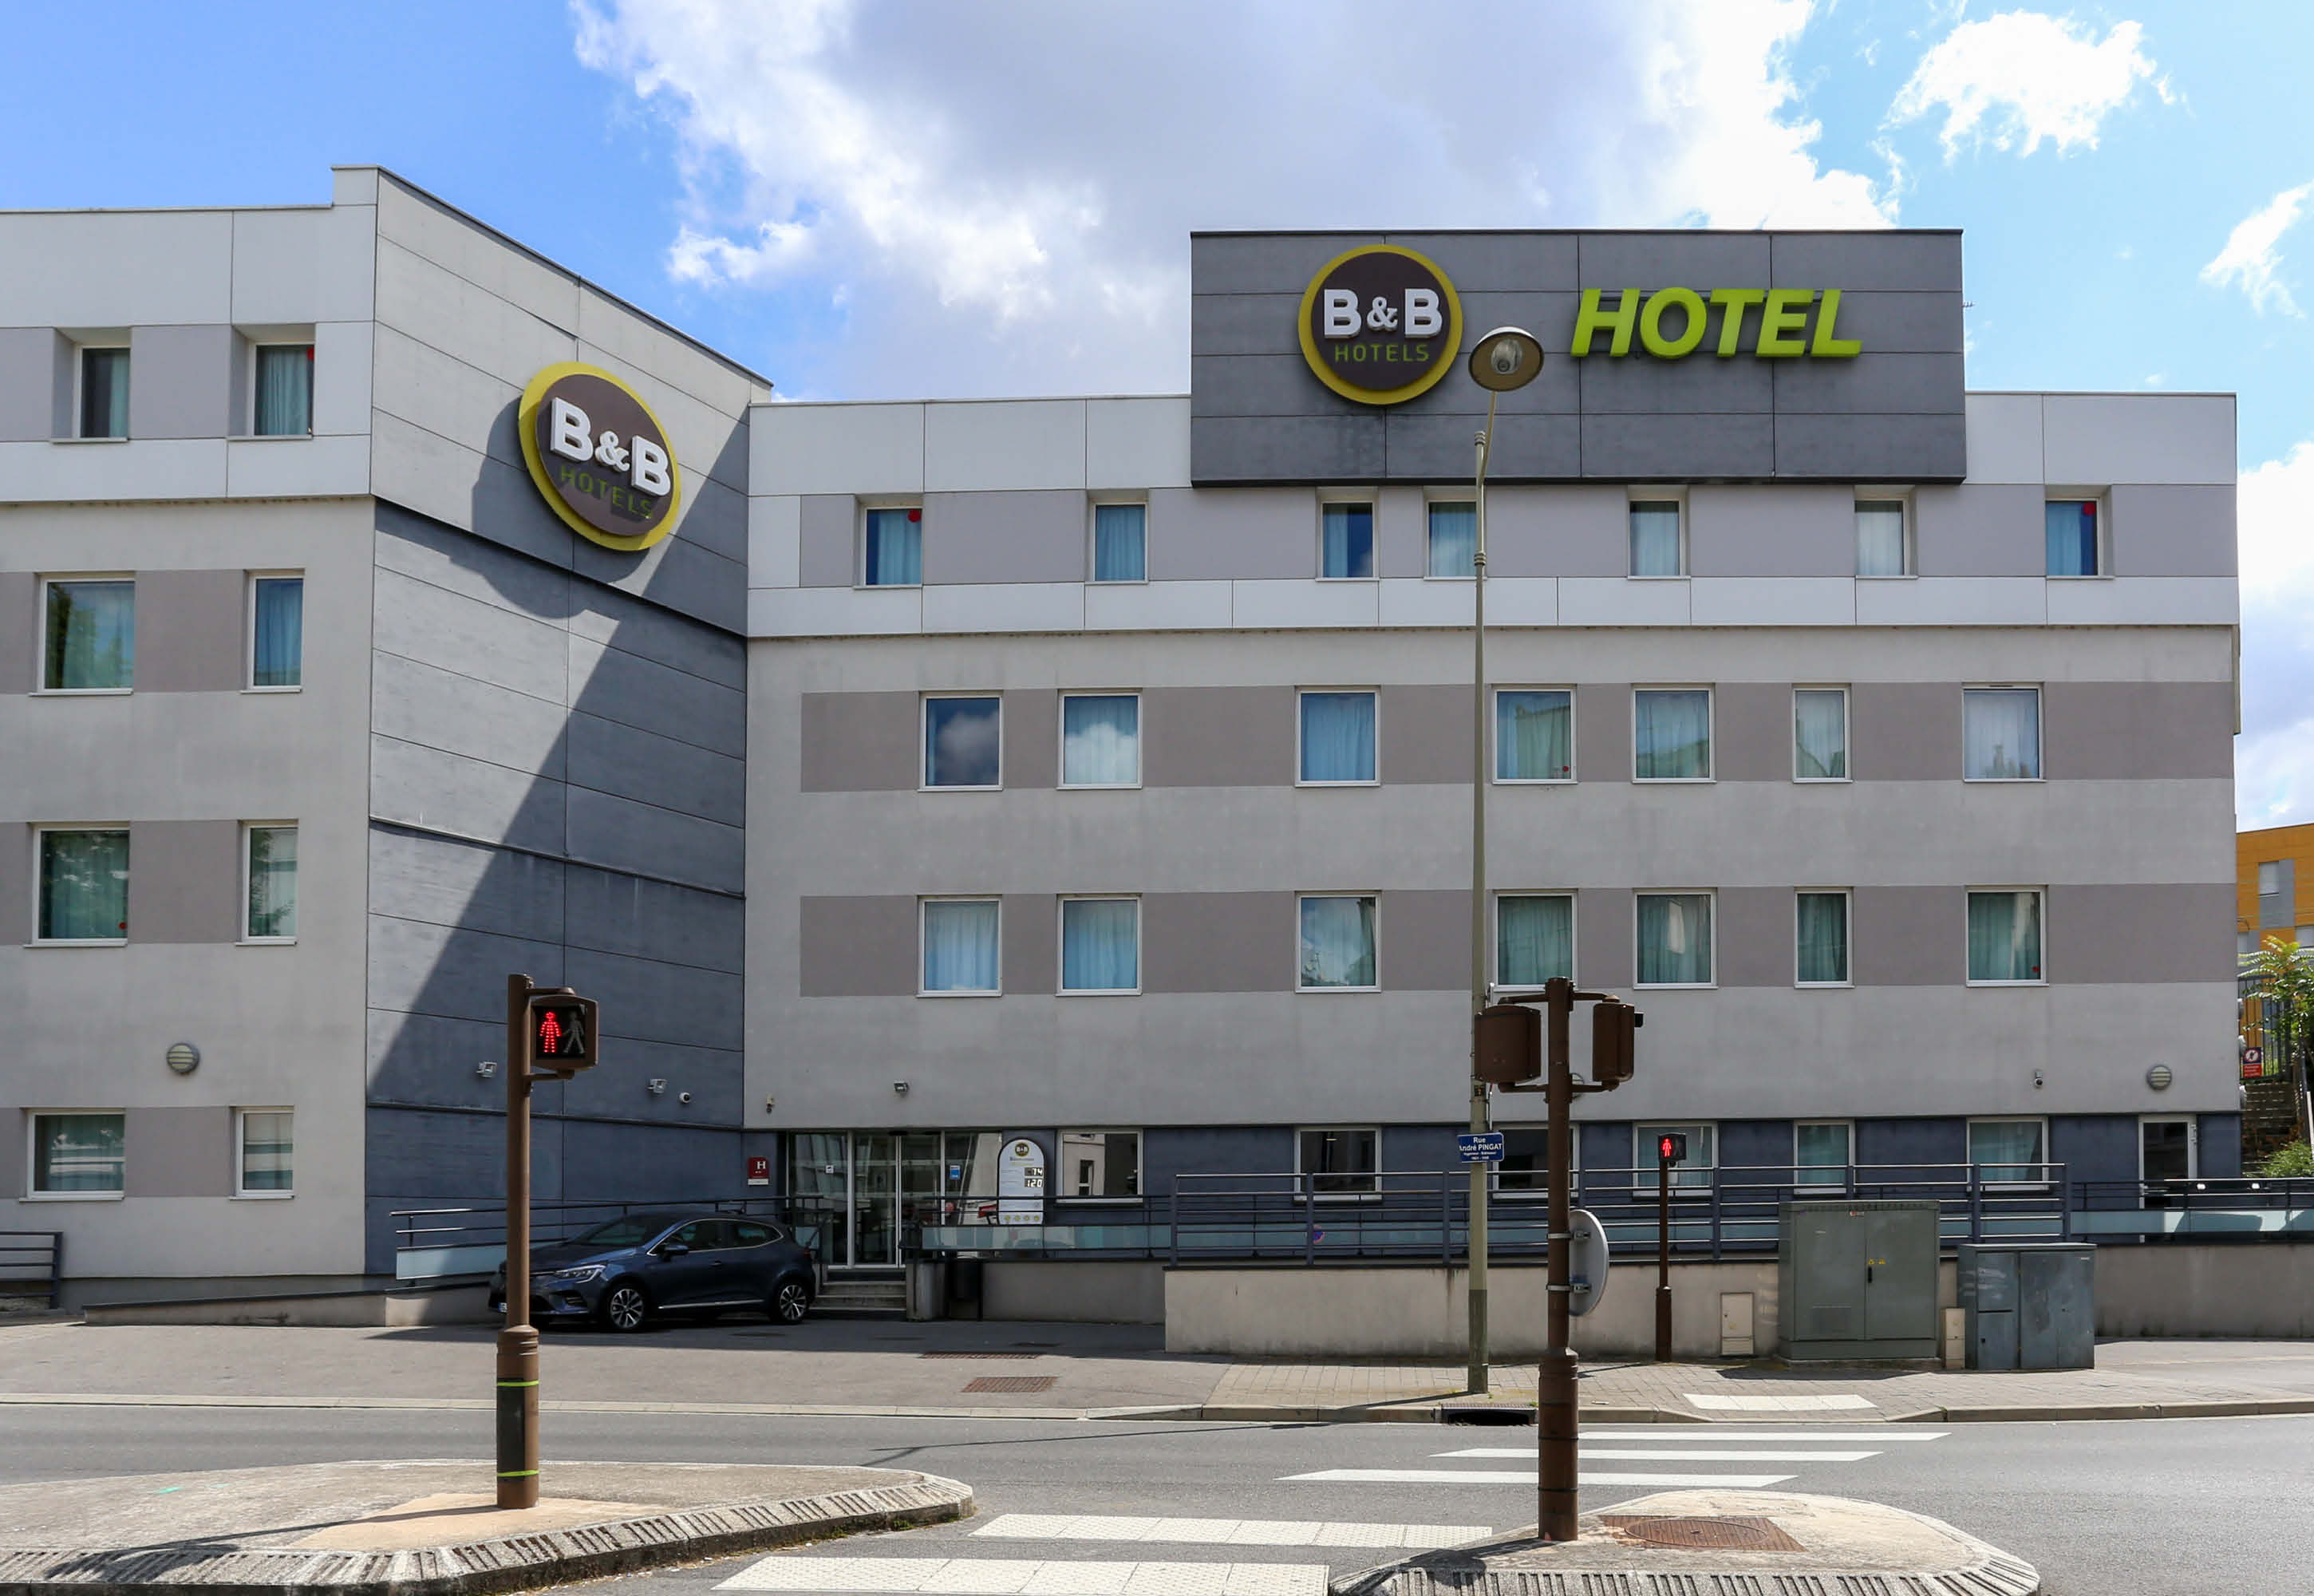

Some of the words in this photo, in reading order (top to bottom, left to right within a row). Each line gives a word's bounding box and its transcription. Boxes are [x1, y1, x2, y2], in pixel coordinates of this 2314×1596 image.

[1323, 288, 1443, 339] B&B
[1570, 286, 1862, 359] HOTEL
[1335, 343, 1429, 362] HOTELS
[550, 397, 671, 496] B&B
[561, 465, 652, 519] HOTELS
[1027, 1179, 1043, 1187] 120
